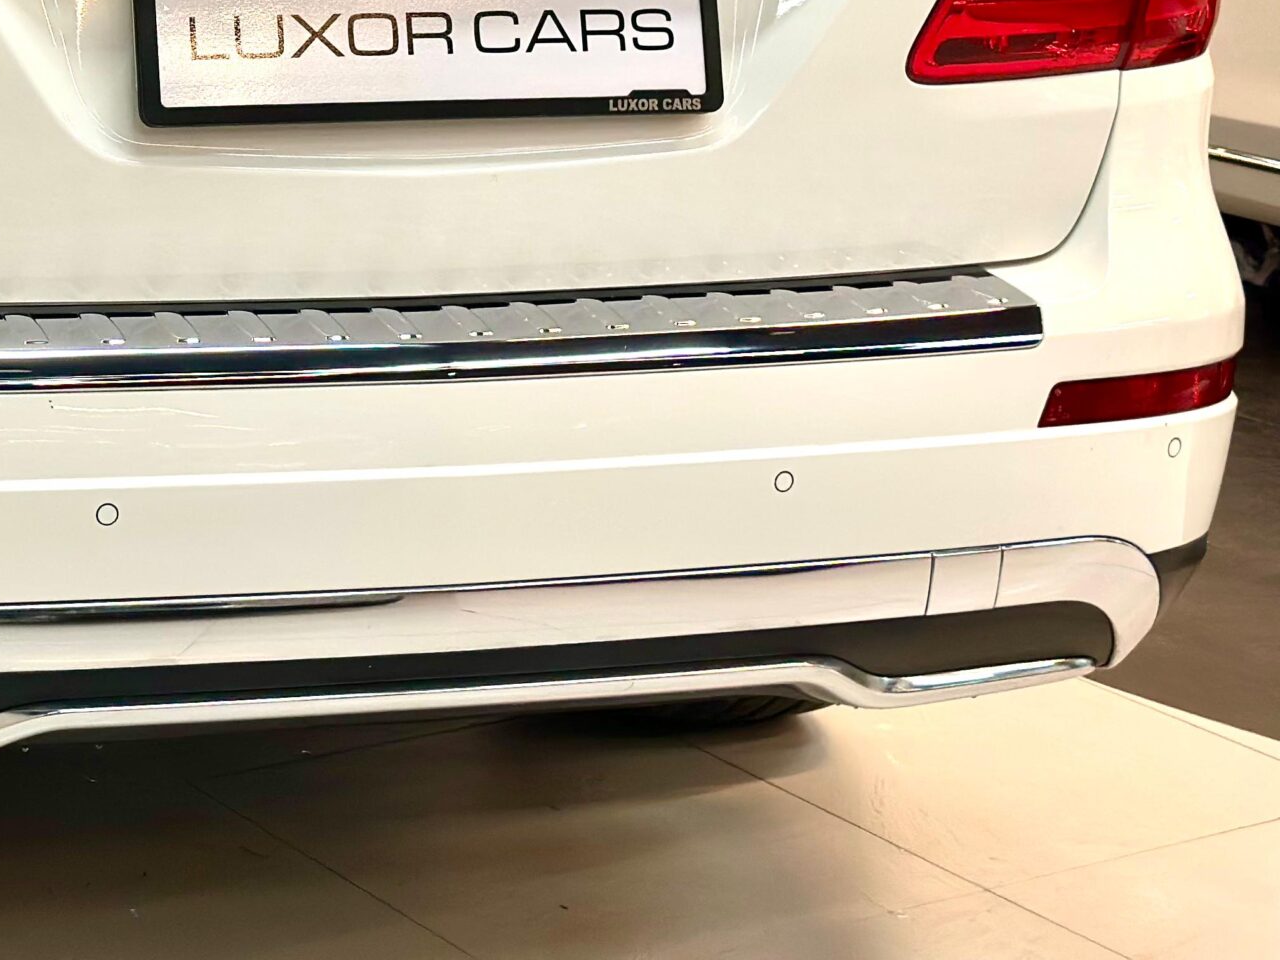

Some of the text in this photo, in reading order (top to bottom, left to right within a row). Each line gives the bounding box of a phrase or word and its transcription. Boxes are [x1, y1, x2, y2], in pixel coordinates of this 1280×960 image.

[190, 8, 675, 61] LUXOR CARS
[609, 97, 702, 112] LUXOR CARS
